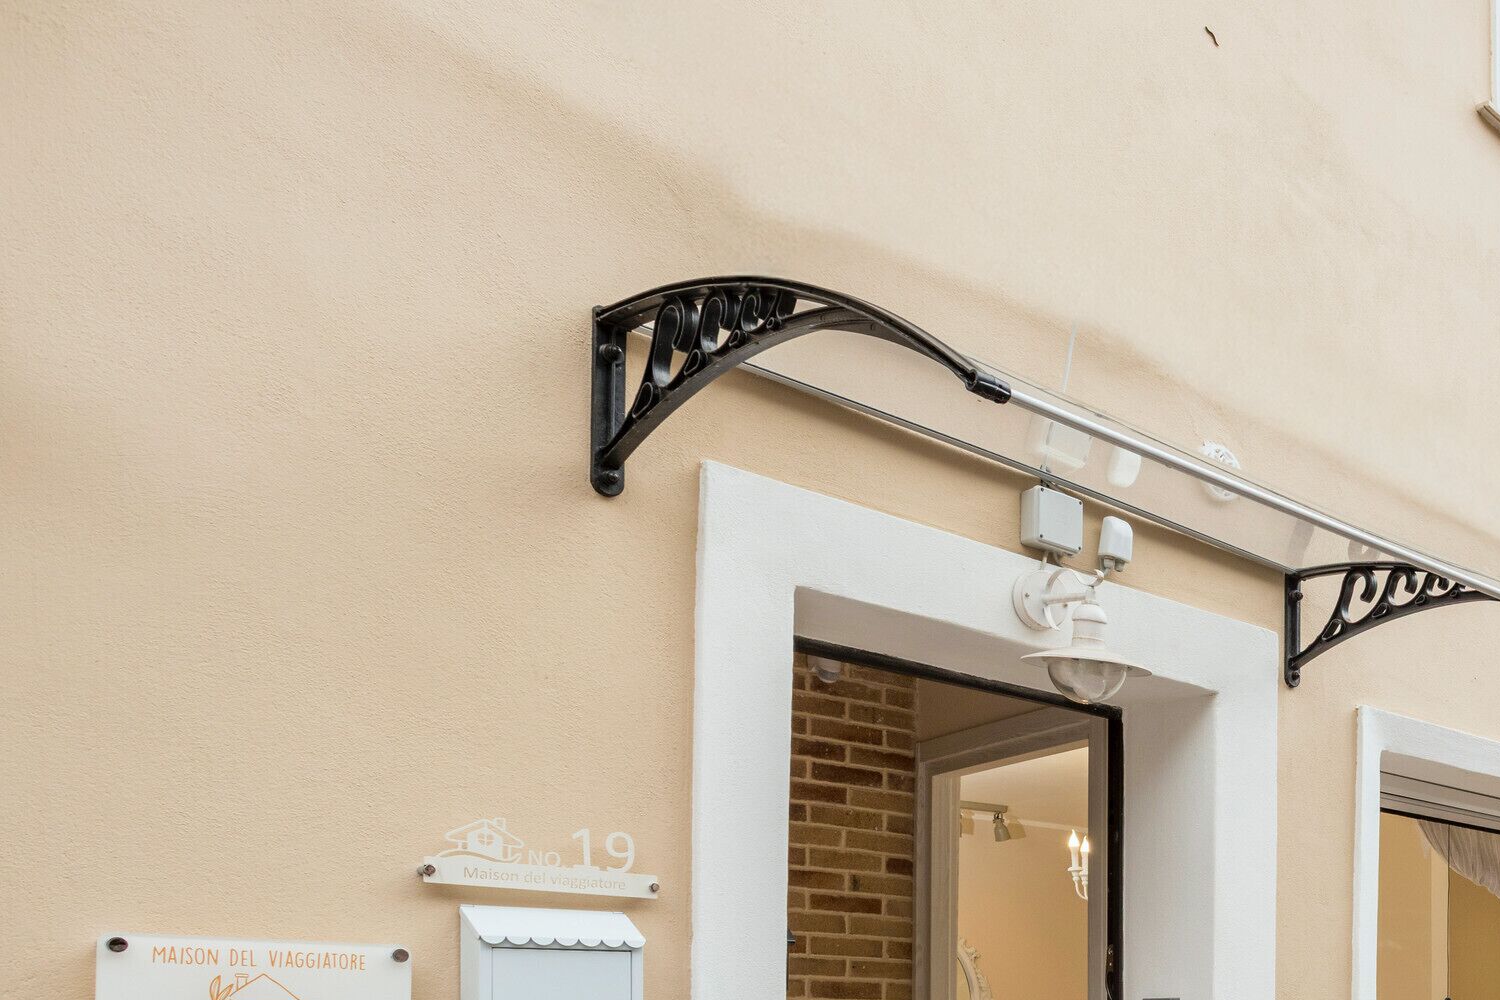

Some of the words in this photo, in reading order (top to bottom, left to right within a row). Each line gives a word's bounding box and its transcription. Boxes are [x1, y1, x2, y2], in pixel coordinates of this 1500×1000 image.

[572, 828, 636, 872] 19
[463, 867, 519, 881] Maison
[524, 871, 546, 884] del
[551, 873, 627, 890] viaggiatore
[151, 946, 219, 966] MAISON
[229, 949, 257, 967] DEL
[269, 950, 366, 971] VIAGGIATORE
